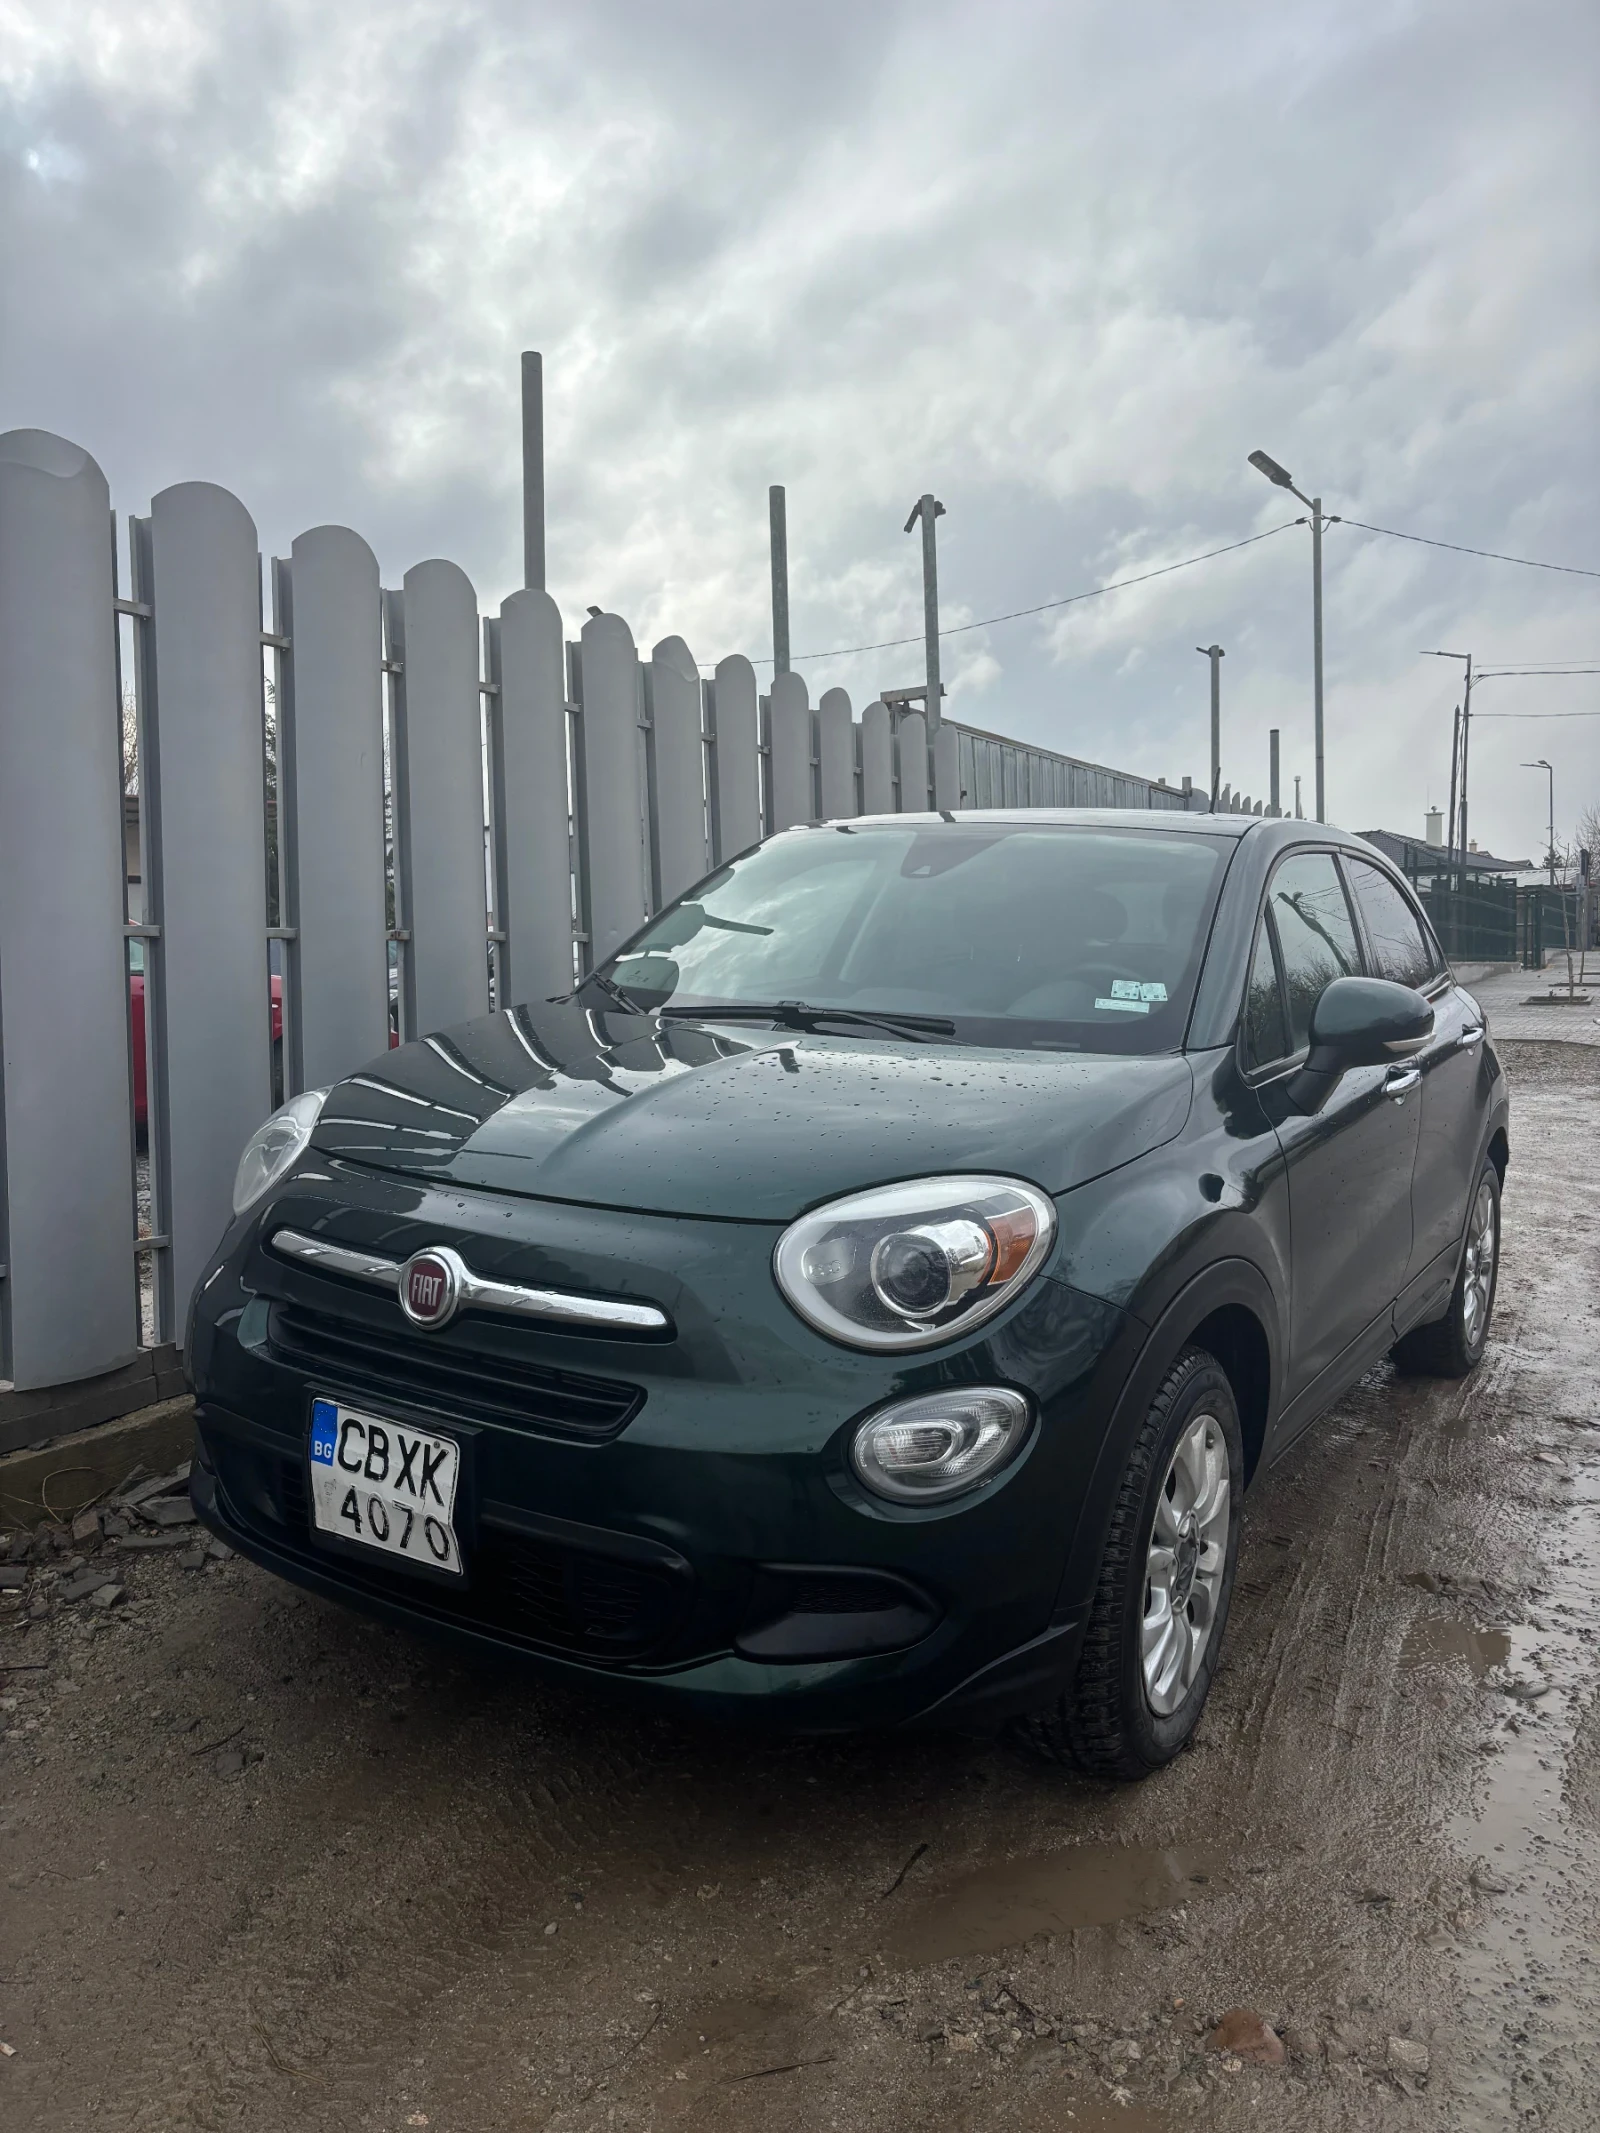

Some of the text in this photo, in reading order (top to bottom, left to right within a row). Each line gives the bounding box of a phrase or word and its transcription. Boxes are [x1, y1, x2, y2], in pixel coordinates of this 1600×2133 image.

[411, 1273, 442, 1307] FIAT
[314, 1440, 333, 1459] BG
[337, 1418, 450, 1507] CBXK
[340, 1485, 450, 1562] 4070
